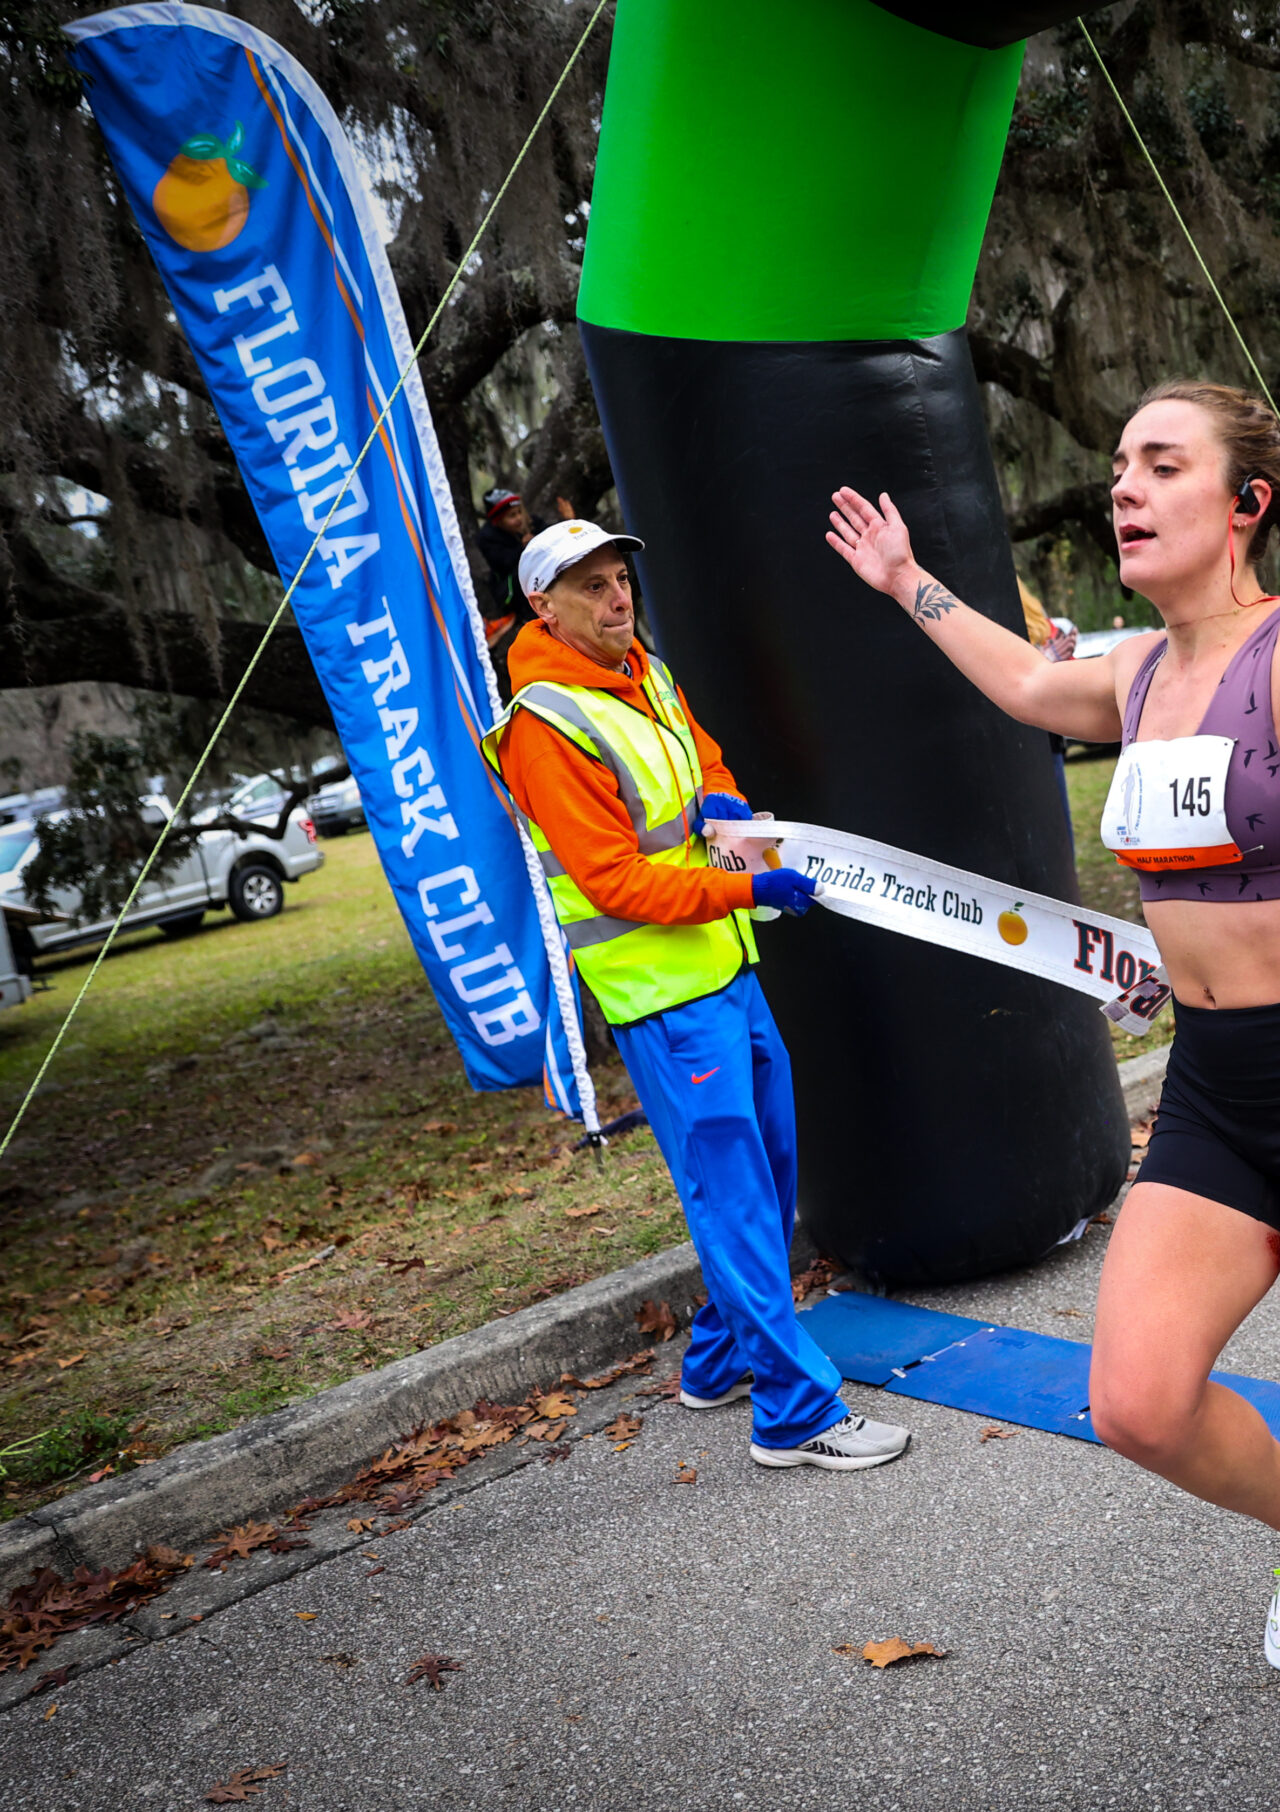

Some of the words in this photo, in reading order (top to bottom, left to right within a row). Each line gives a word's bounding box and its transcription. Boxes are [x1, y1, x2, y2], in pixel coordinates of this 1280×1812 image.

[213, 264, 381, 589] FLORIDA
[346, 595, 460, 859] TRACK
[417, 864, 541, 1047] CLUB
[1169, 776, 1211, 817] 145
[709, 845, 747, 872] Club
[1154, 855, 1195, 863] MARATHON
[805, 855, 876, 894] Florida
[880, 872, 938, 913] Track
[942, 890, 983, 926] Club
